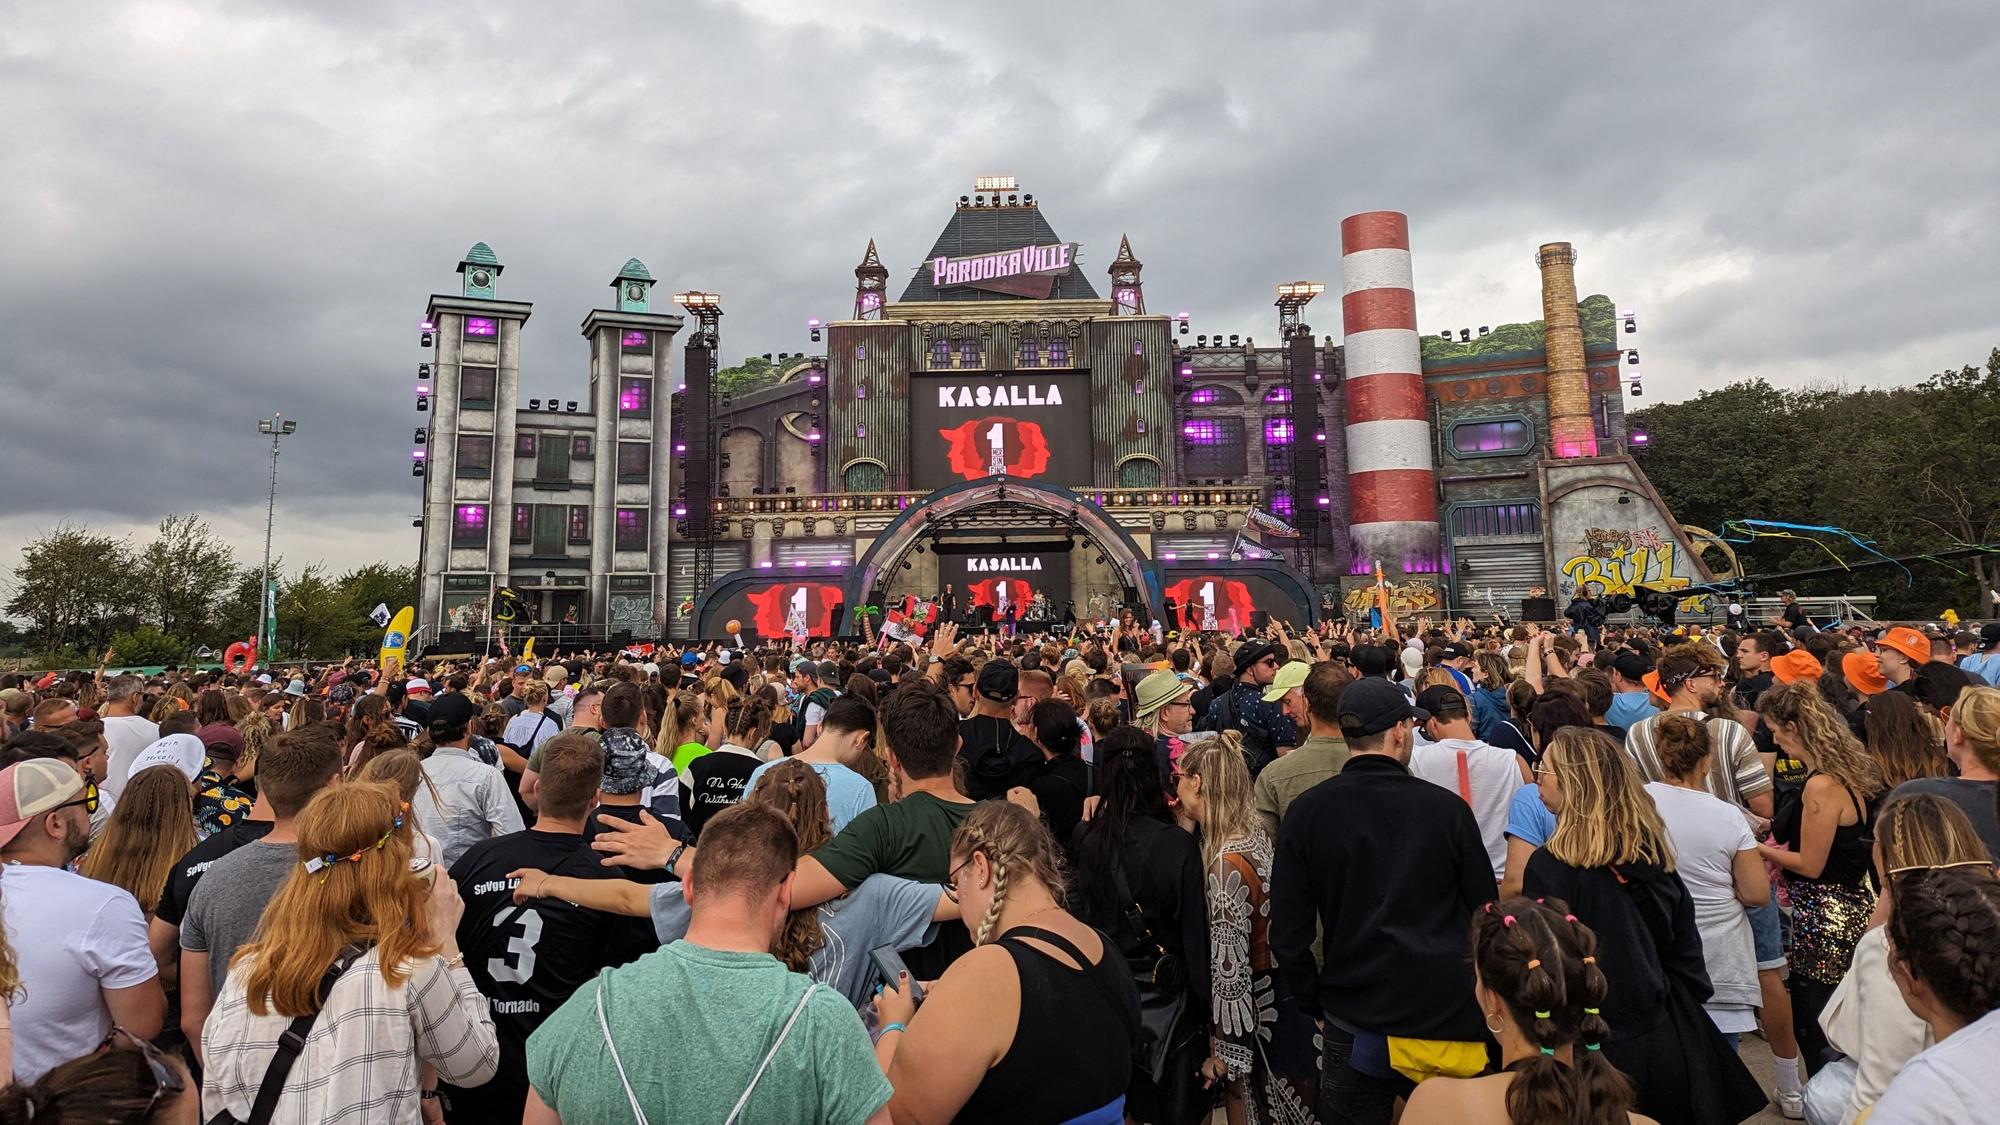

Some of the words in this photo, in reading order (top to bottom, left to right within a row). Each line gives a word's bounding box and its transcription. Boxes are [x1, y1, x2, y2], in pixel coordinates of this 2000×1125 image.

[938, 384, 1063, 408] KASALLA
[986, 422, 1004, 449] 1
[967, 557, 1042, 572] KASALLA
[791, 587, 807, 611] 1
[1199, 581, 1215, 604] 1
[474, 880, 506, 895] SpVgg
[487, 905, 544, 985] 3
[492, 999, 540, 1014] Tornado
